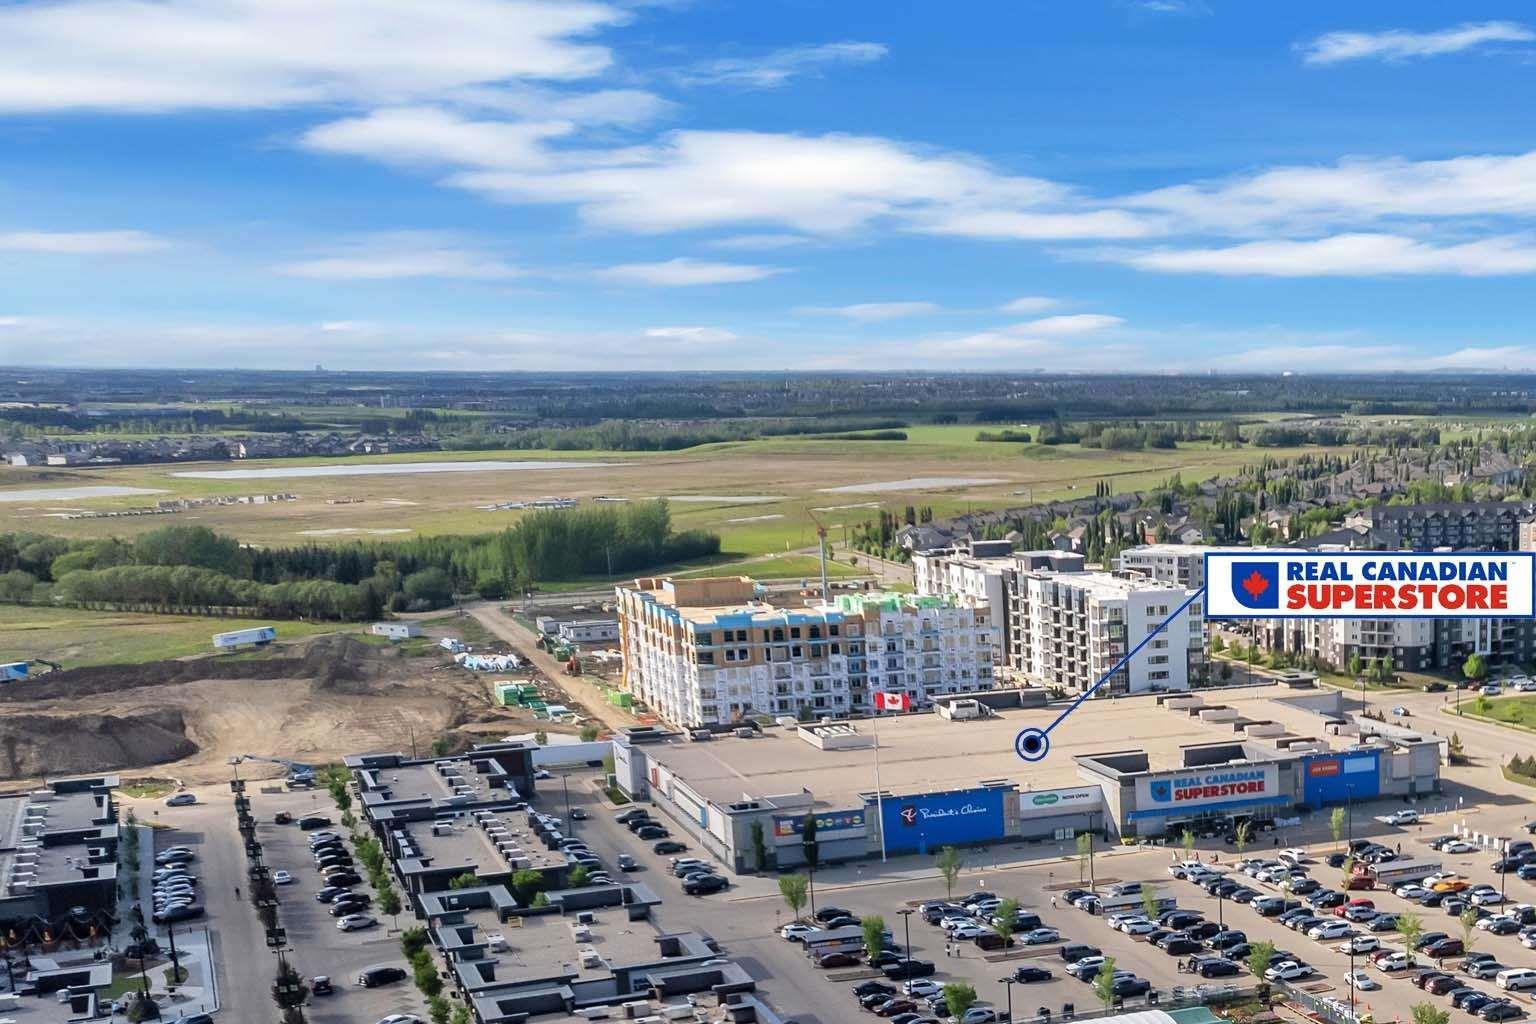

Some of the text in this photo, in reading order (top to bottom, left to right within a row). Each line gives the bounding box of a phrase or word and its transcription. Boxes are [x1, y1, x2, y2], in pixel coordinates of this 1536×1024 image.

[1174, 770, 1265, 788] REAL CANADIAN
[1174, 780, 1265, 801] SUPERSTORE
